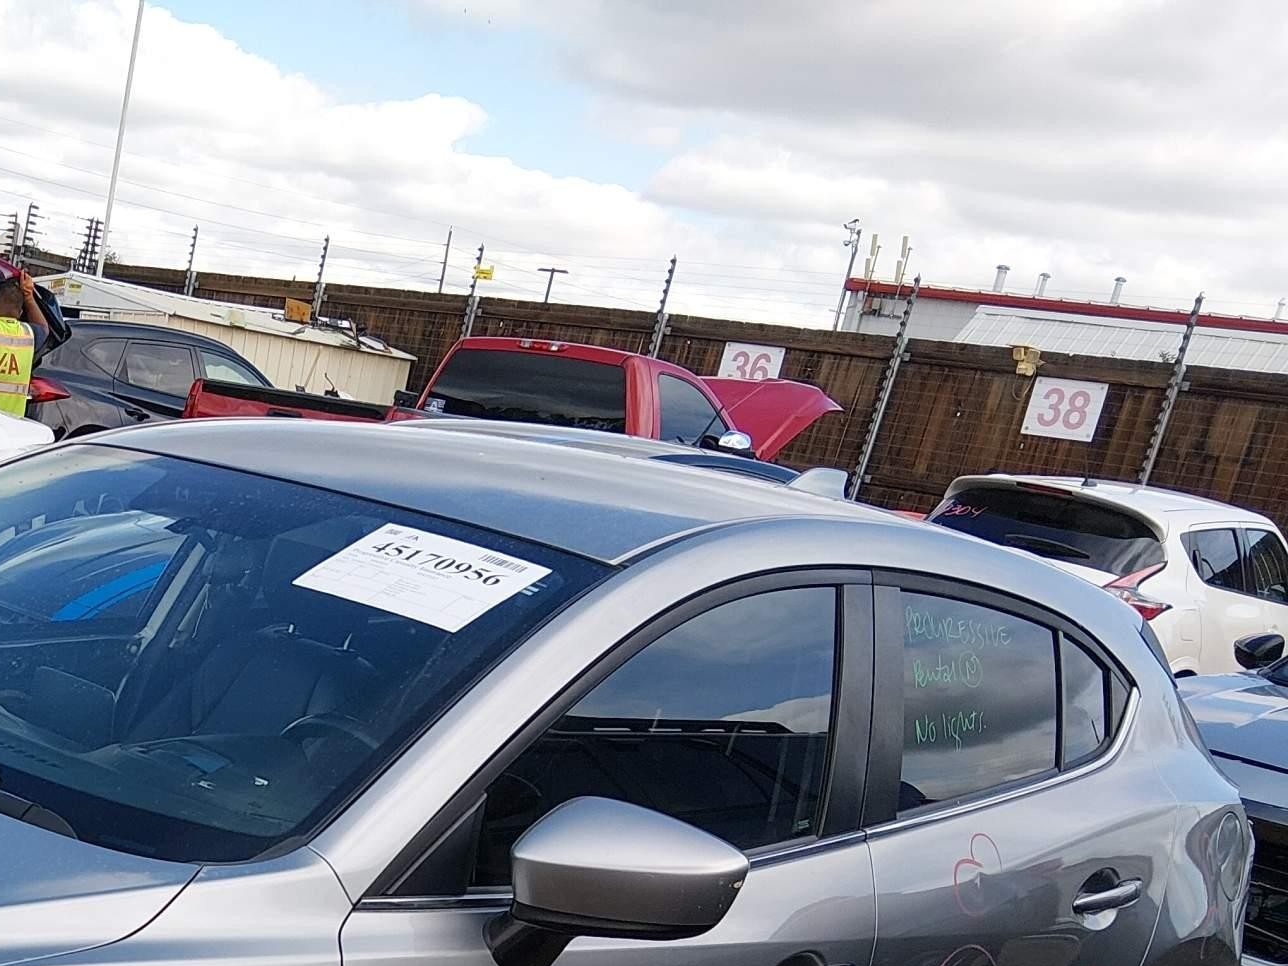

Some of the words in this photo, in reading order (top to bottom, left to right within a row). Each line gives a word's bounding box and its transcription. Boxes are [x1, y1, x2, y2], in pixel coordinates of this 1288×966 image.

[731, 350, 772, 379] 36
[1037, 387, 1091, 430] 38
[372, 541, 508, 587] 45170956
[915, 714, 936, 745] No
